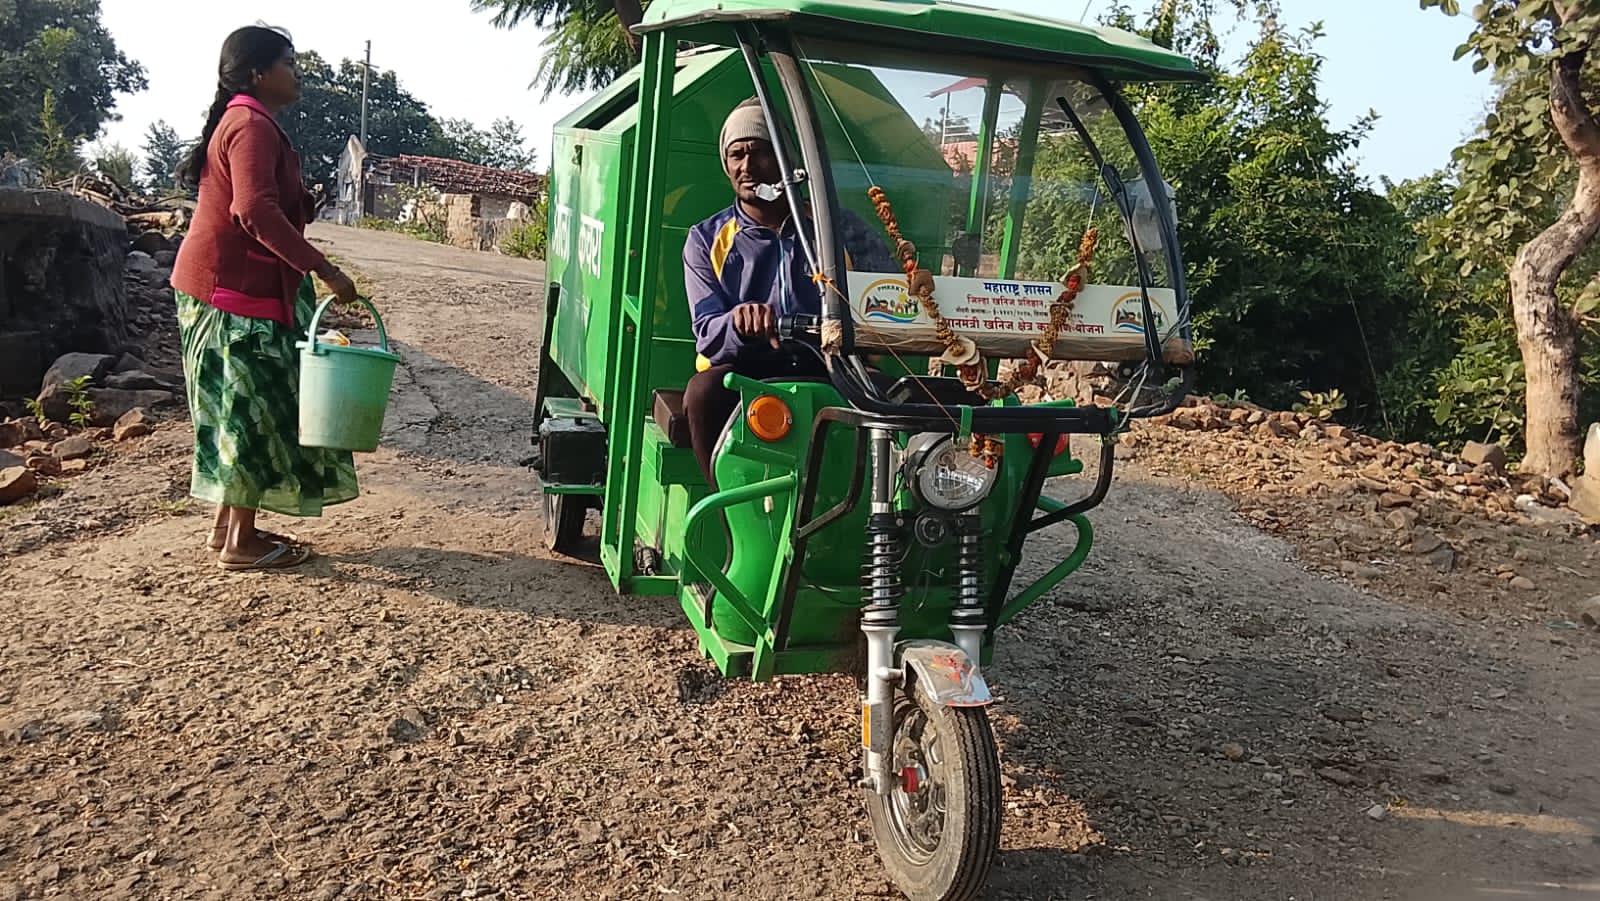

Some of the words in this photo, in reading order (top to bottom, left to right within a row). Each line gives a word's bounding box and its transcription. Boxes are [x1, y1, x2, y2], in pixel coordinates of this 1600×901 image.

[984, 283, 1020, 297] महाराष्ट्र
[1023, 284, 1053, 297] शासन
[967, 293, 990, 304] जिल्हा
[992, 295, 1015, 306] खनिज
[983, 317, 1014, 330] खनिज
[1018, 318, 1033, 332] क्षेत्र
